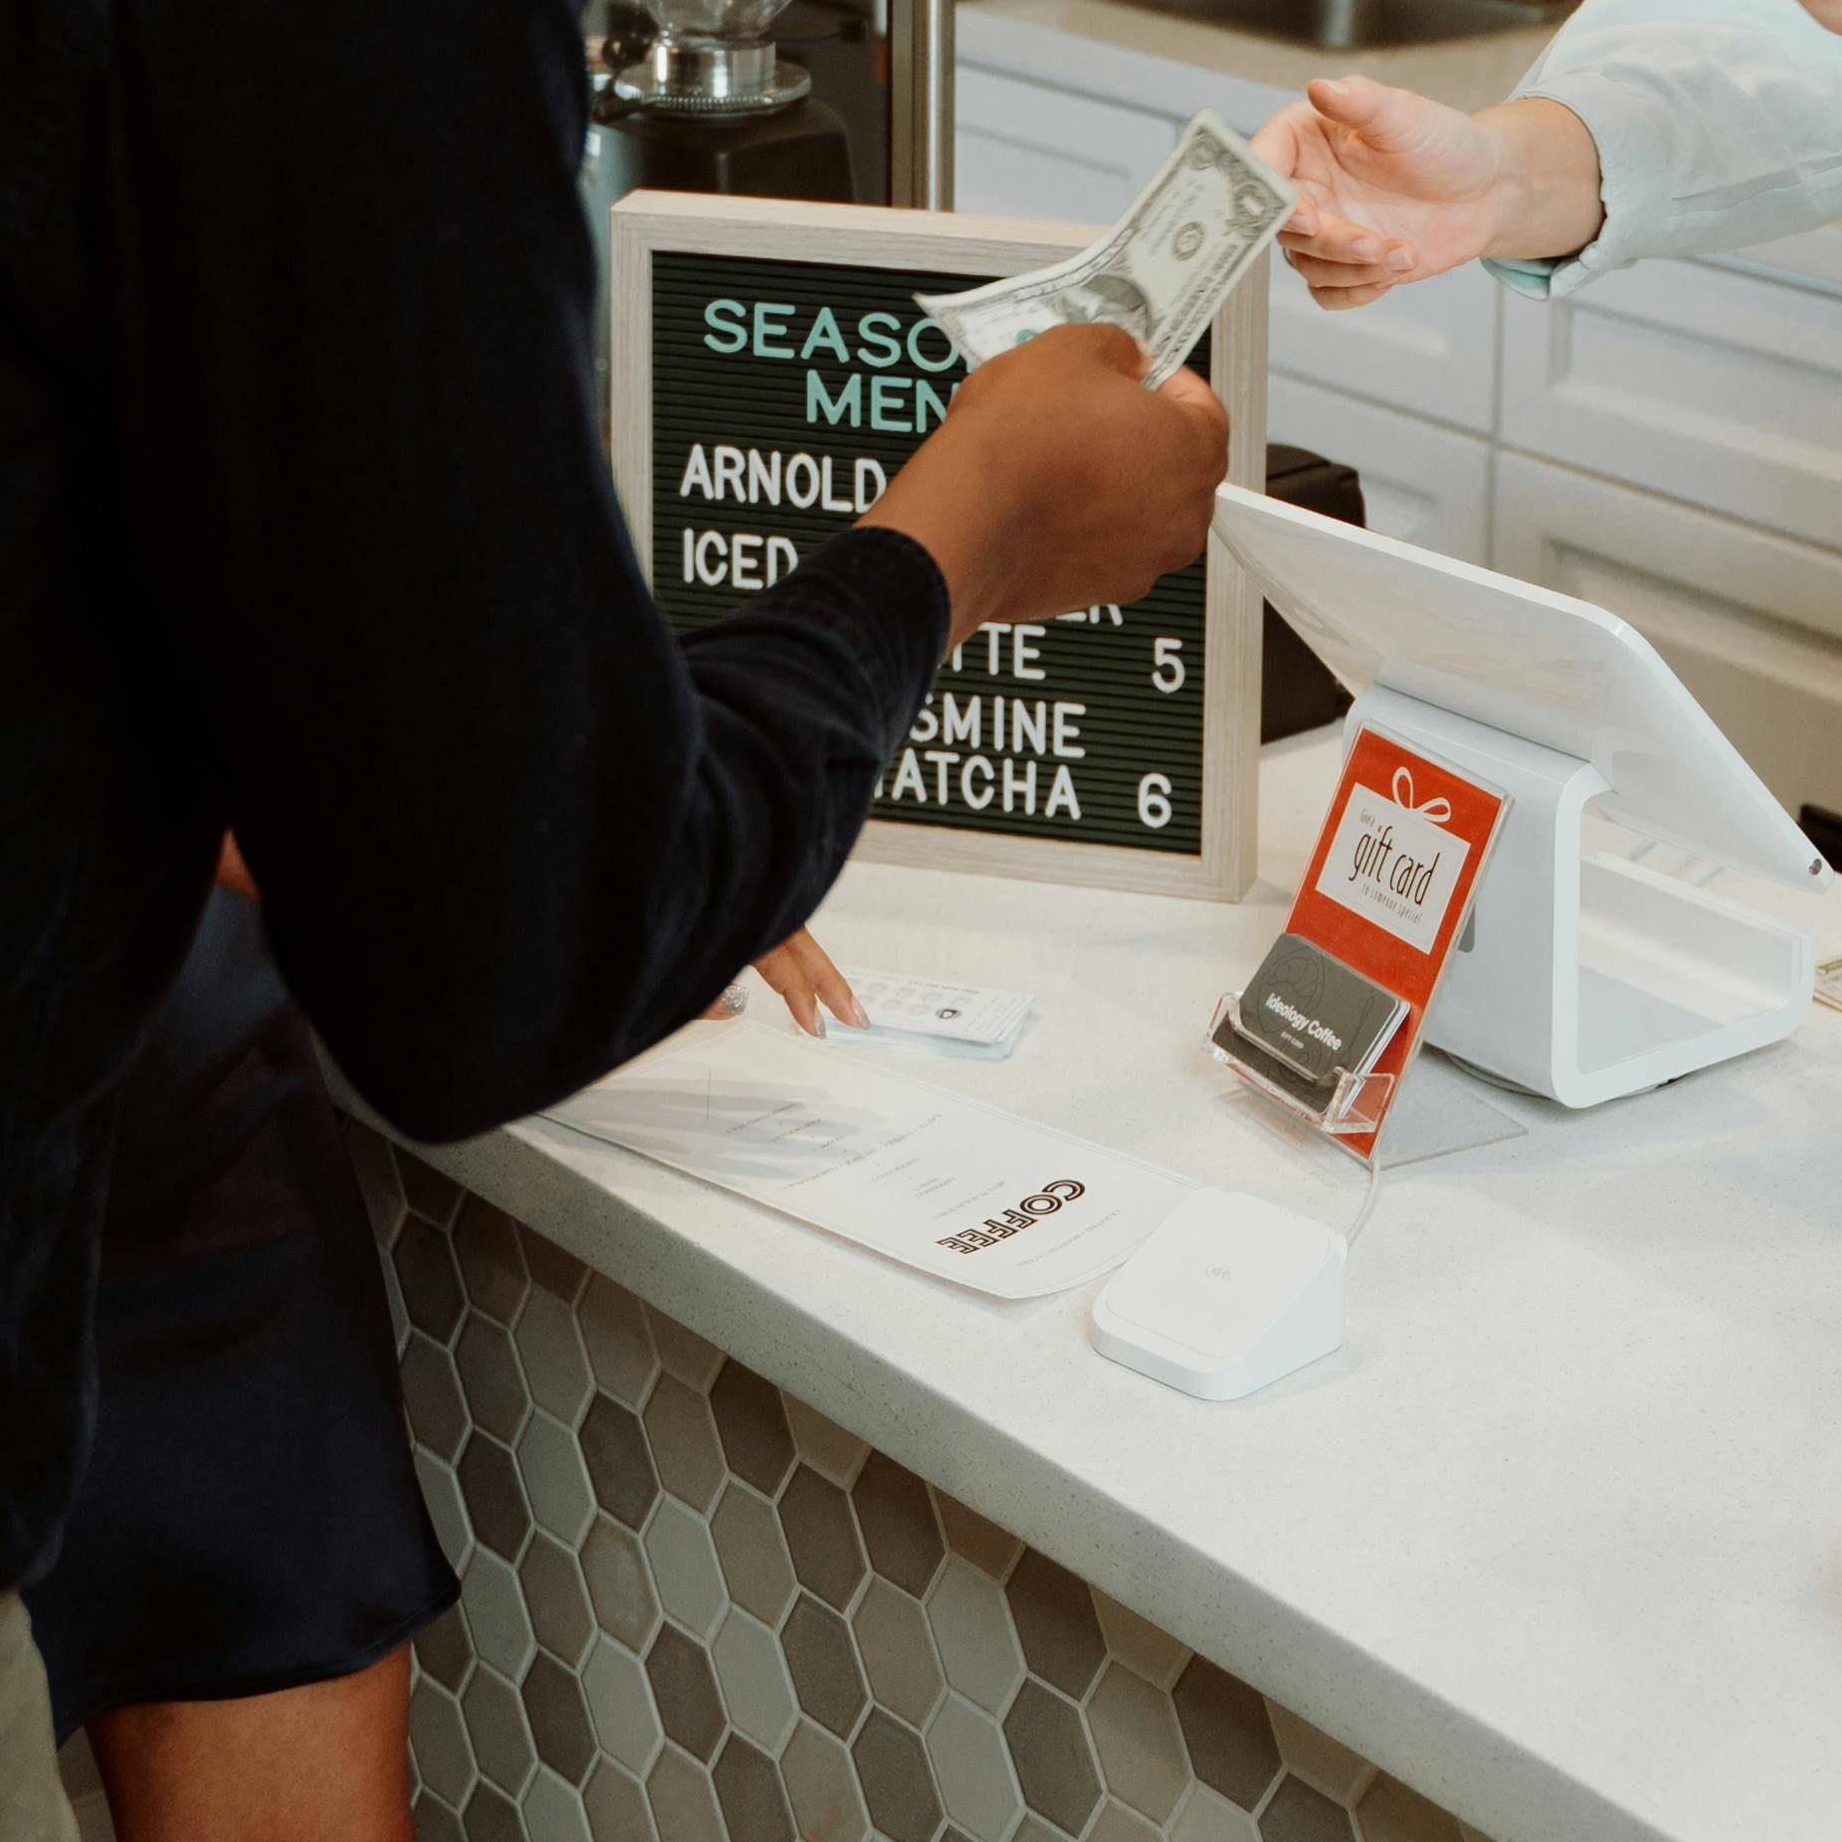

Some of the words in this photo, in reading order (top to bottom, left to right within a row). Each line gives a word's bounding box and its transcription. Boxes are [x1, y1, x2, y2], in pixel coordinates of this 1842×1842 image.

[704, 299, 973, 374] SEASO
[679, 443, 887, 514] ARNOLD
[683, 527, 799, 590] ICED
[1151, 637, 1186, 693] 5
[874, 748, 1082, 821] ATCHA
[1137, 772, 1173, 829] 6
[1348, 824, 1394, 883] gift
[1389, 851, 1441, 908] card
[1265, 993, 1310, 1032] Ideology
[1307, 1019, 1345, 1051] Coffee
[934, 1178, 1086, 1254] COFFEE
